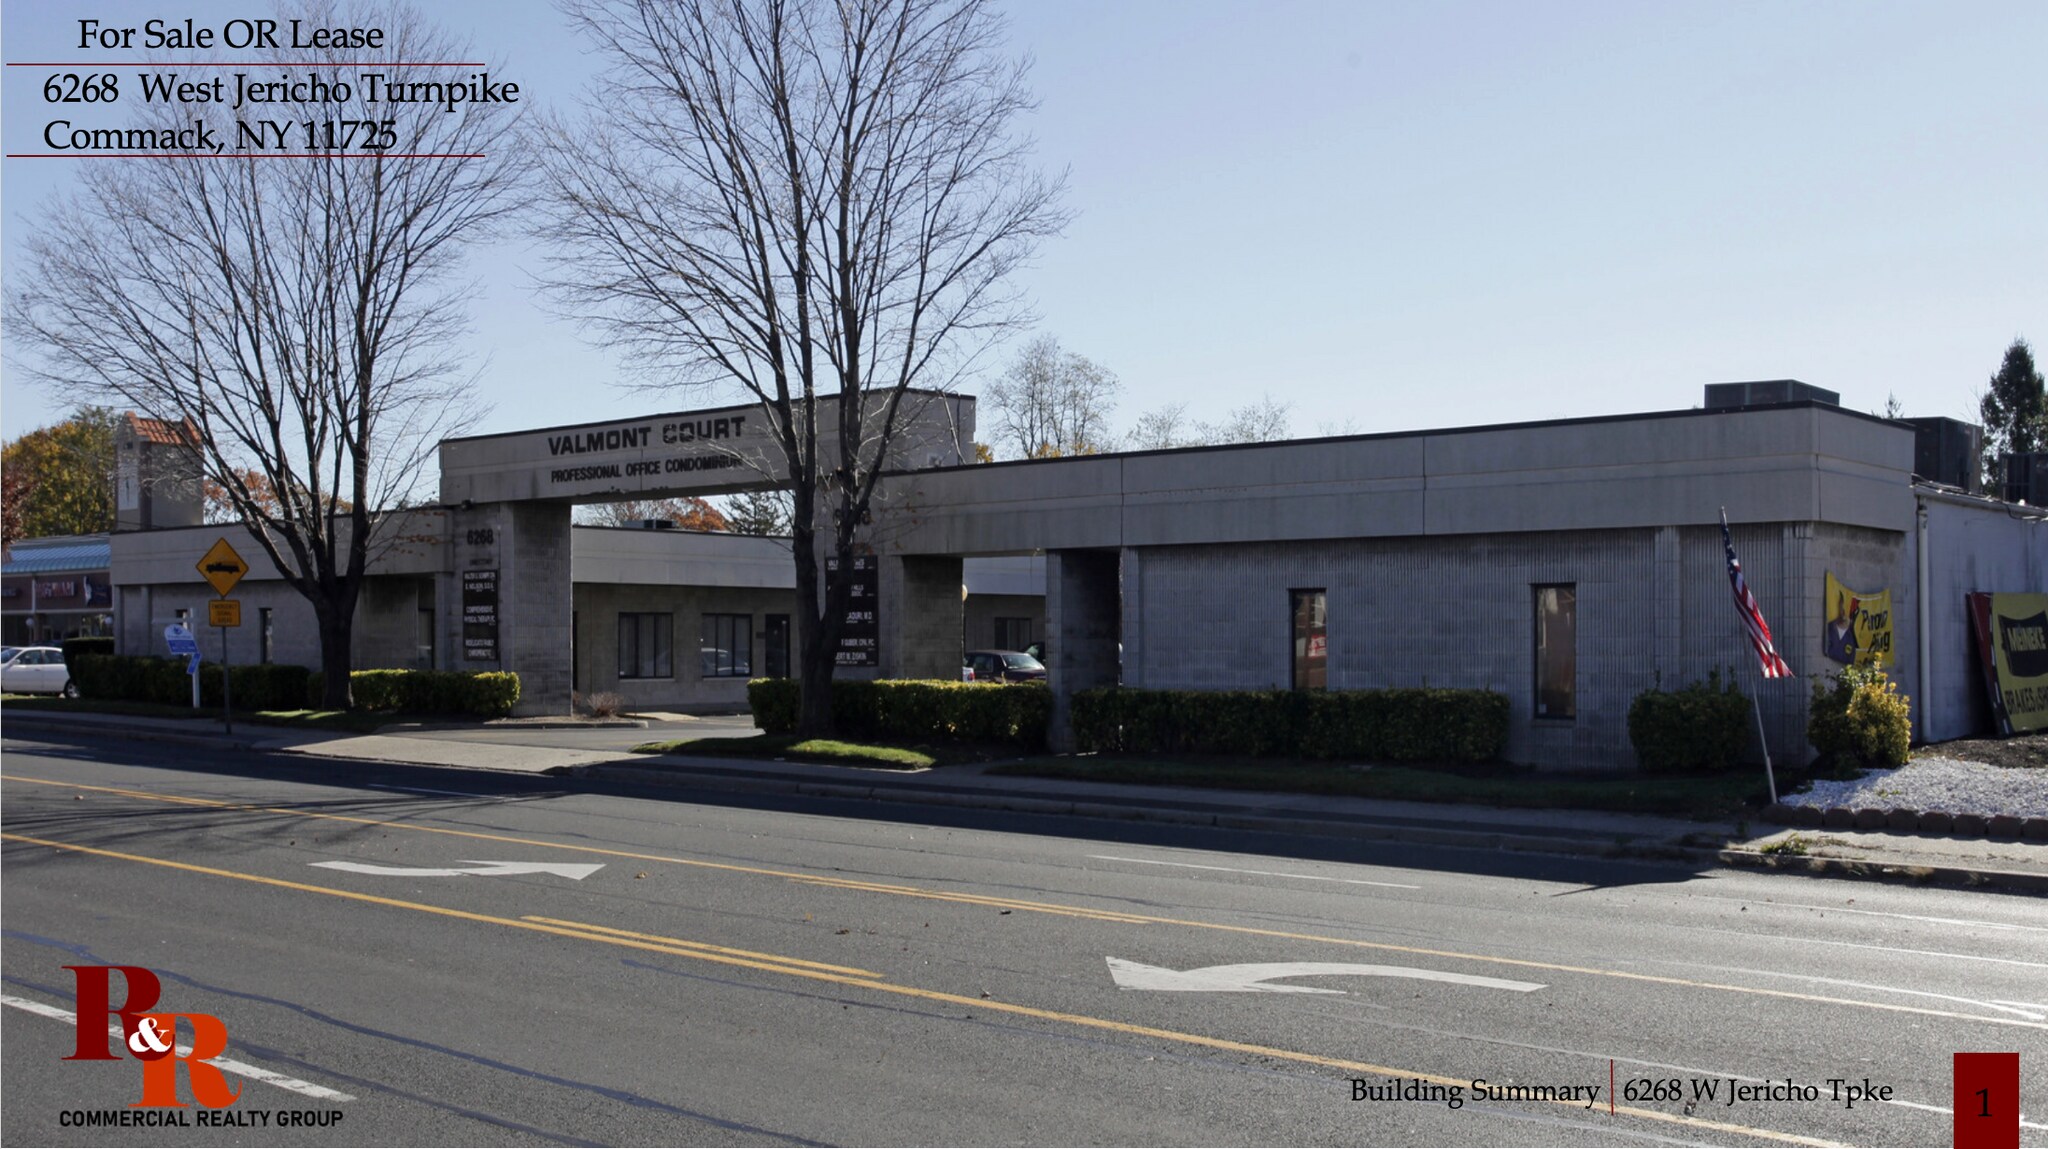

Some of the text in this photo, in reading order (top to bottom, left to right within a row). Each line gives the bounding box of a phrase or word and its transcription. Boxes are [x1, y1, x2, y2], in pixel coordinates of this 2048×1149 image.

[548, 416, 745, 456] VALMONT COURT
[551, 464, 622, 483] PROFESSIONAL
[626, 461, 661, 477] OFFICE
[467, 529, 494, 545] 6268
